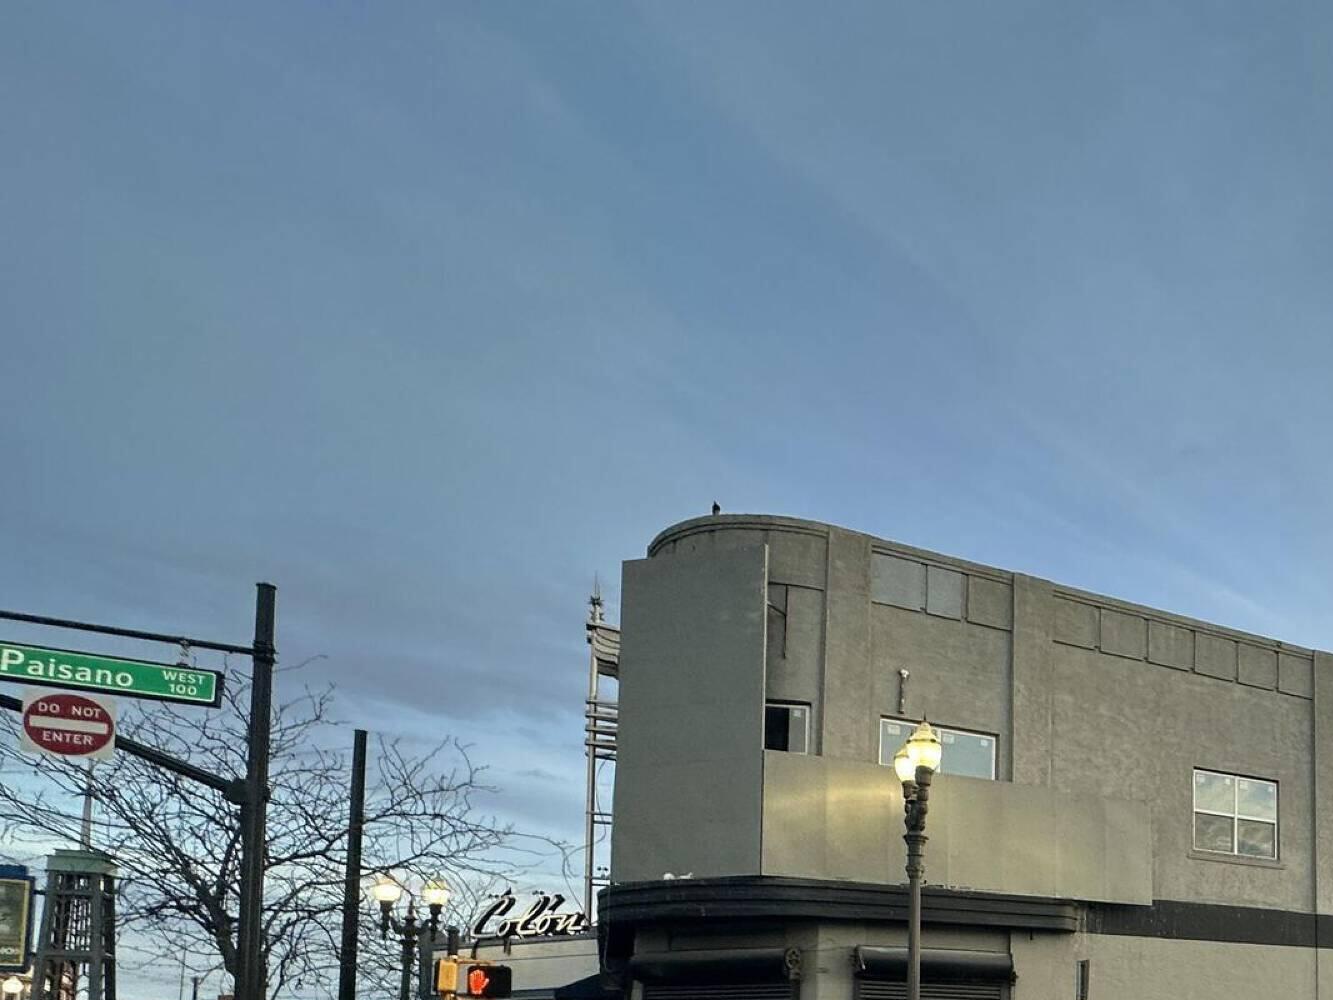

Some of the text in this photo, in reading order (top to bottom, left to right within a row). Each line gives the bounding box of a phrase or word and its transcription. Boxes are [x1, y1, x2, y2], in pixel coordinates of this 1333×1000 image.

[0, 649, 134, 688] Paisano
[163, 669, 205, 685] WEST
[168, 683, 198, 697] 100
[38, 702, 102, 719] DO NOT
[42, 730, 95, 746] ENTER
